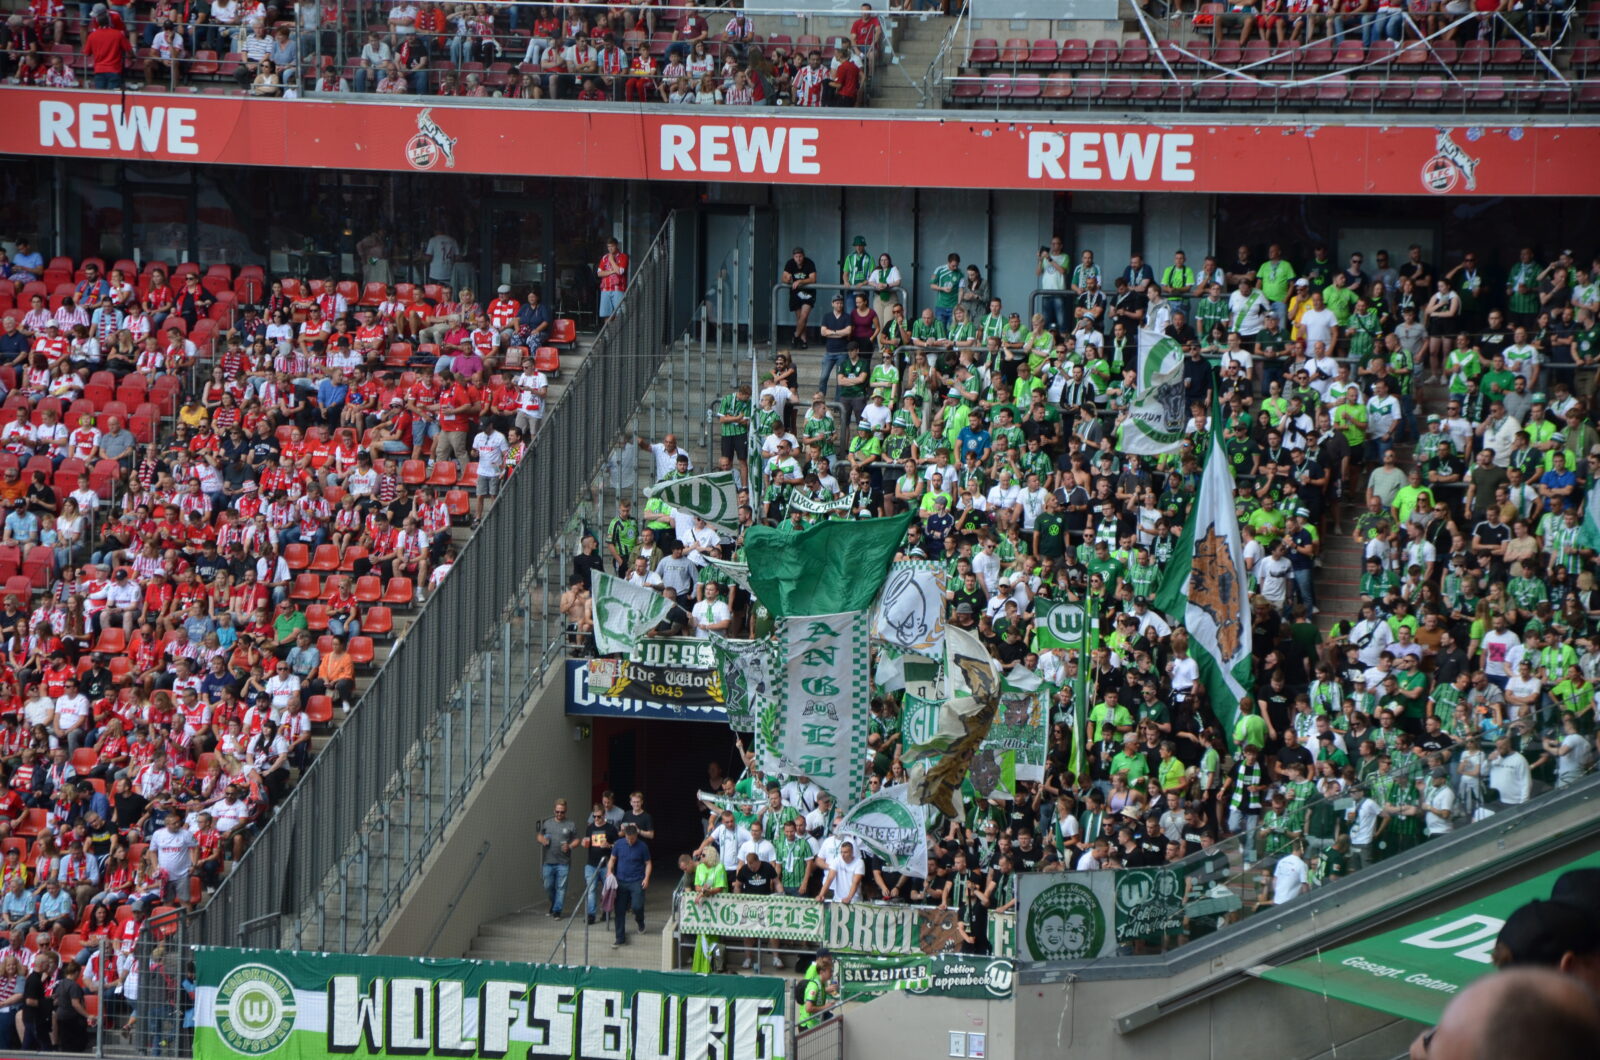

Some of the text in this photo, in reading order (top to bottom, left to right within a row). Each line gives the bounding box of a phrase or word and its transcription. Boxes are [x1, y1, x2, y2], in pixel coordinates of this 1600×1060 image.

[39, 100, 199, 154] REWE
[660, 124, 821, 174] REWE
[1028, 132, 1194, 181] REWE
[650, 683, 684, 698] 1945
[844, 965, 928, 982] SALZGITTER
[943, 964, 976, 975] Sektion
[1342, 956, 1459, 994] Gesagt. Getan.
[328, 974, 776, 1060] WOLFSBURG
